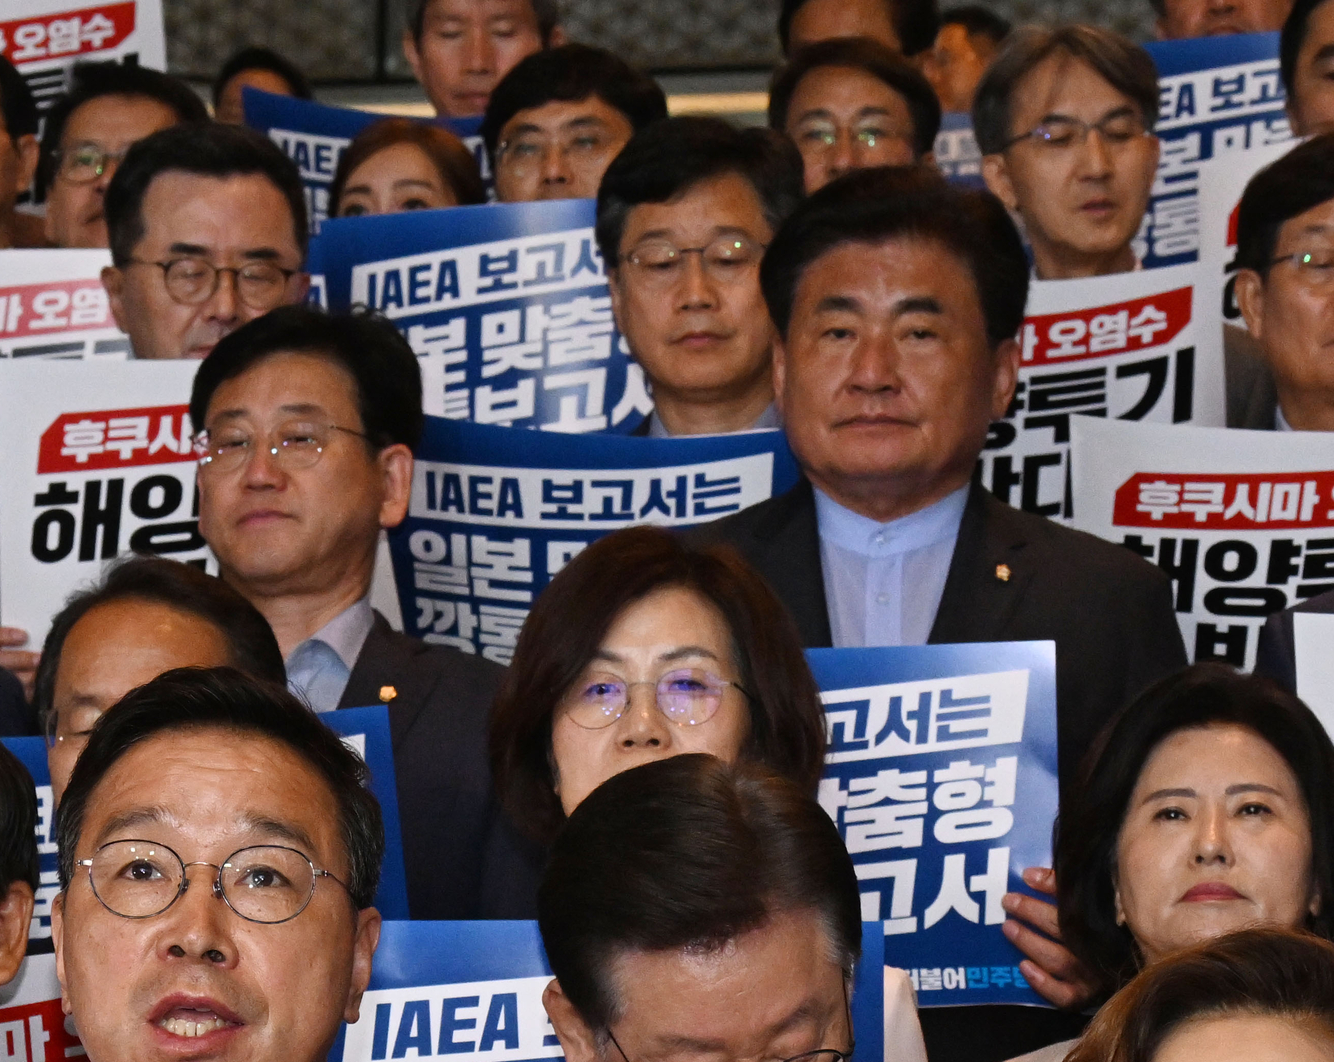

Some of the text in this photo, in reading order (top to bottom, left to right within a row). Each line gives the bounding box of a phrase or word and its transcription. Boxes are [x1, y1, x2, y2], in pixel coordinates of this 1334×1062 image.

[12, 12, 116, 60] 오염수
[367, 258, 461, 310] IAEA
[476, 238, 609, 296] 보고서
[28, 287, 110, 330] 오염
[480, 295, 614, 380] 맞춤
[1047, 302, 1169, 357] 오염수
[60, 413, 195, 463] 후쿠시
[31, 473, 208, 563] 해양
[425, 470, 742, 524] IAEA 보고서는
[1136, 480, 1320, 523] 후쿠시마
[408, 530, 534, 600] 일본
[823, 687, 993, 752] 고서는
[818, 756, 1018, 854] 춤형
[371, 991, 520, 1062] IAEA
